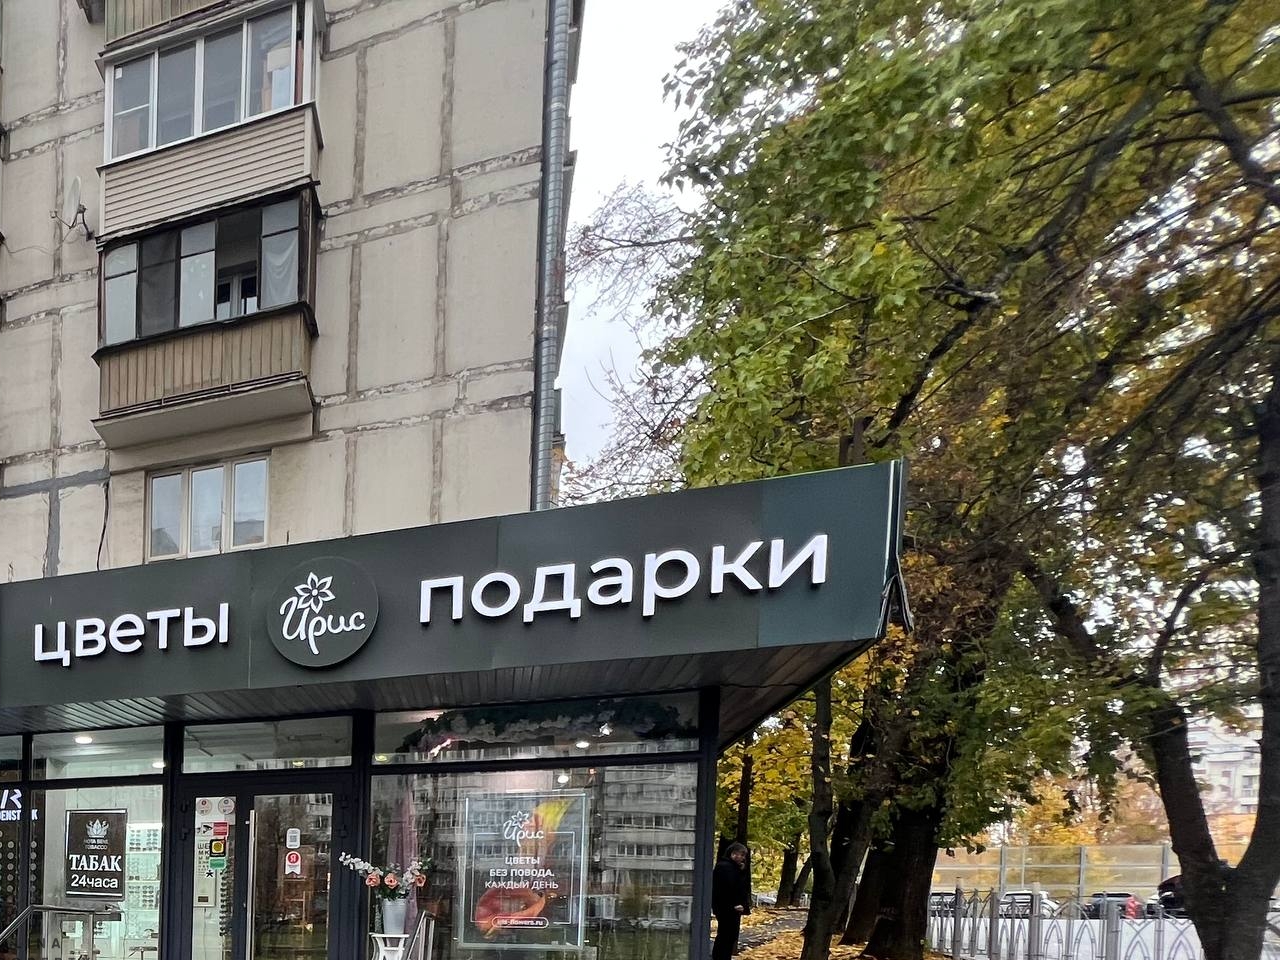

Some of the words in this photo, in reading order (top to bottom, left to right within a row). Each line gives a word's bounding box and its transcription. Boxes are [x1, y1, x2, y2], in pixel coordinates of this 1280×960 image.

[421, 534, 828, 623] подарки
[279, 596, 366, 655] Ирис
[34, 603, 229, 667] цветы
[69, 854, 122, 871] ТАБАК
[505, 856, 540, 865] ЦВЕТЫ
[489, 868, 508, 877] БЕЗ
[71, 874, 118, 888] 24часа
[484, 880, 530, 890] КАЖДЫЙ
[531, 881, 559, 890] ДЕНЬ
